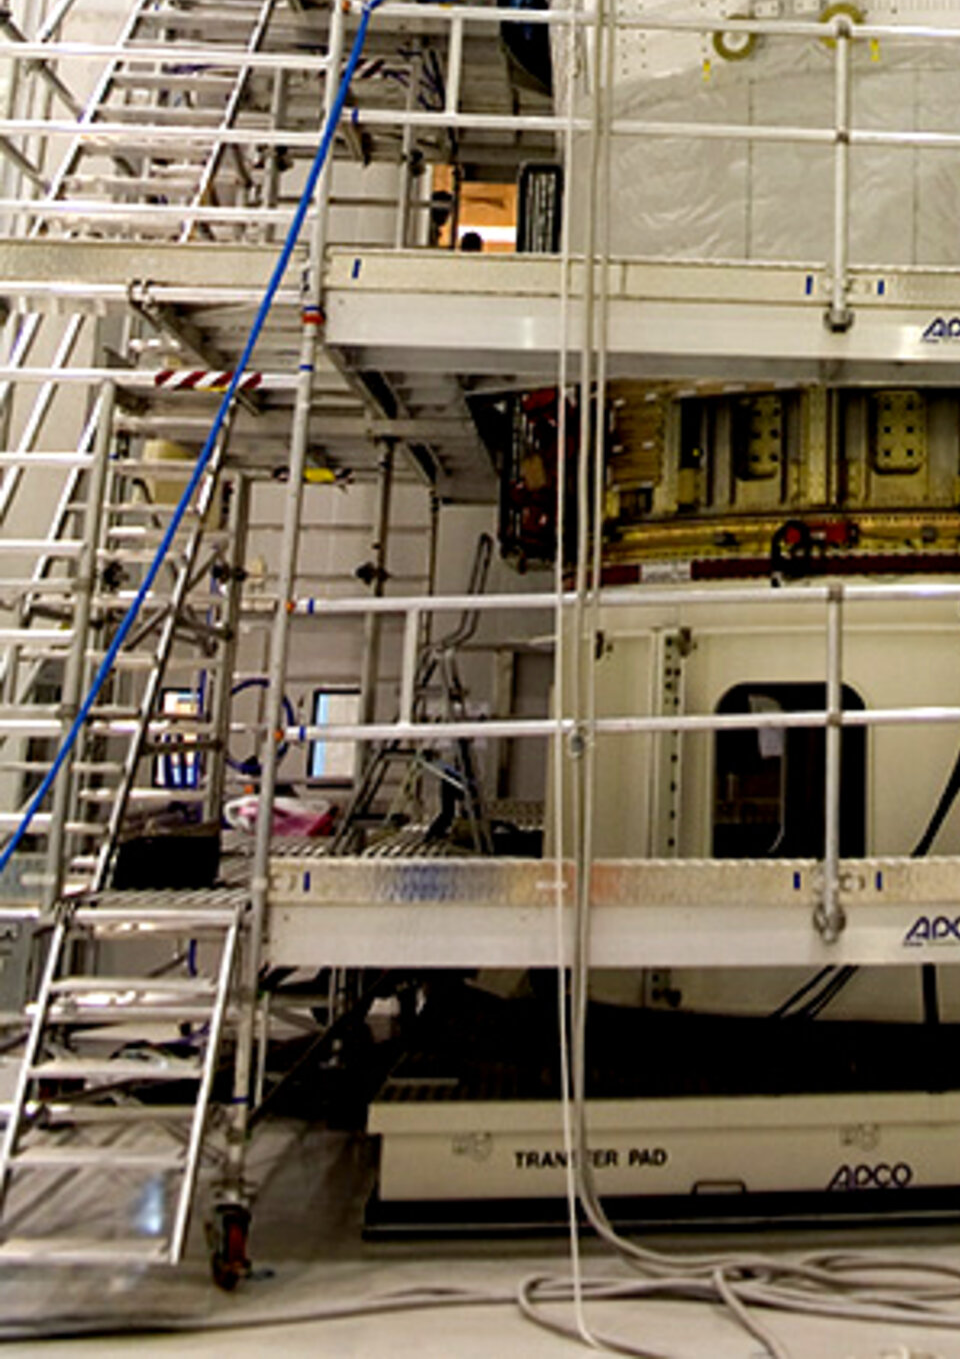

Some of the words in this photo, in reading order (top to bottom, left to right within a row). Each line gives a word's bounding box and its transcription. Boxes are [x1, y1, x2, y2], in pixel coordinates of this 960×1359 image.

[514, 1149, 618, 1168] TRANER
[628, 1147, 668, 1167] PAD
[826, 1161, 914, 1191] APCO
